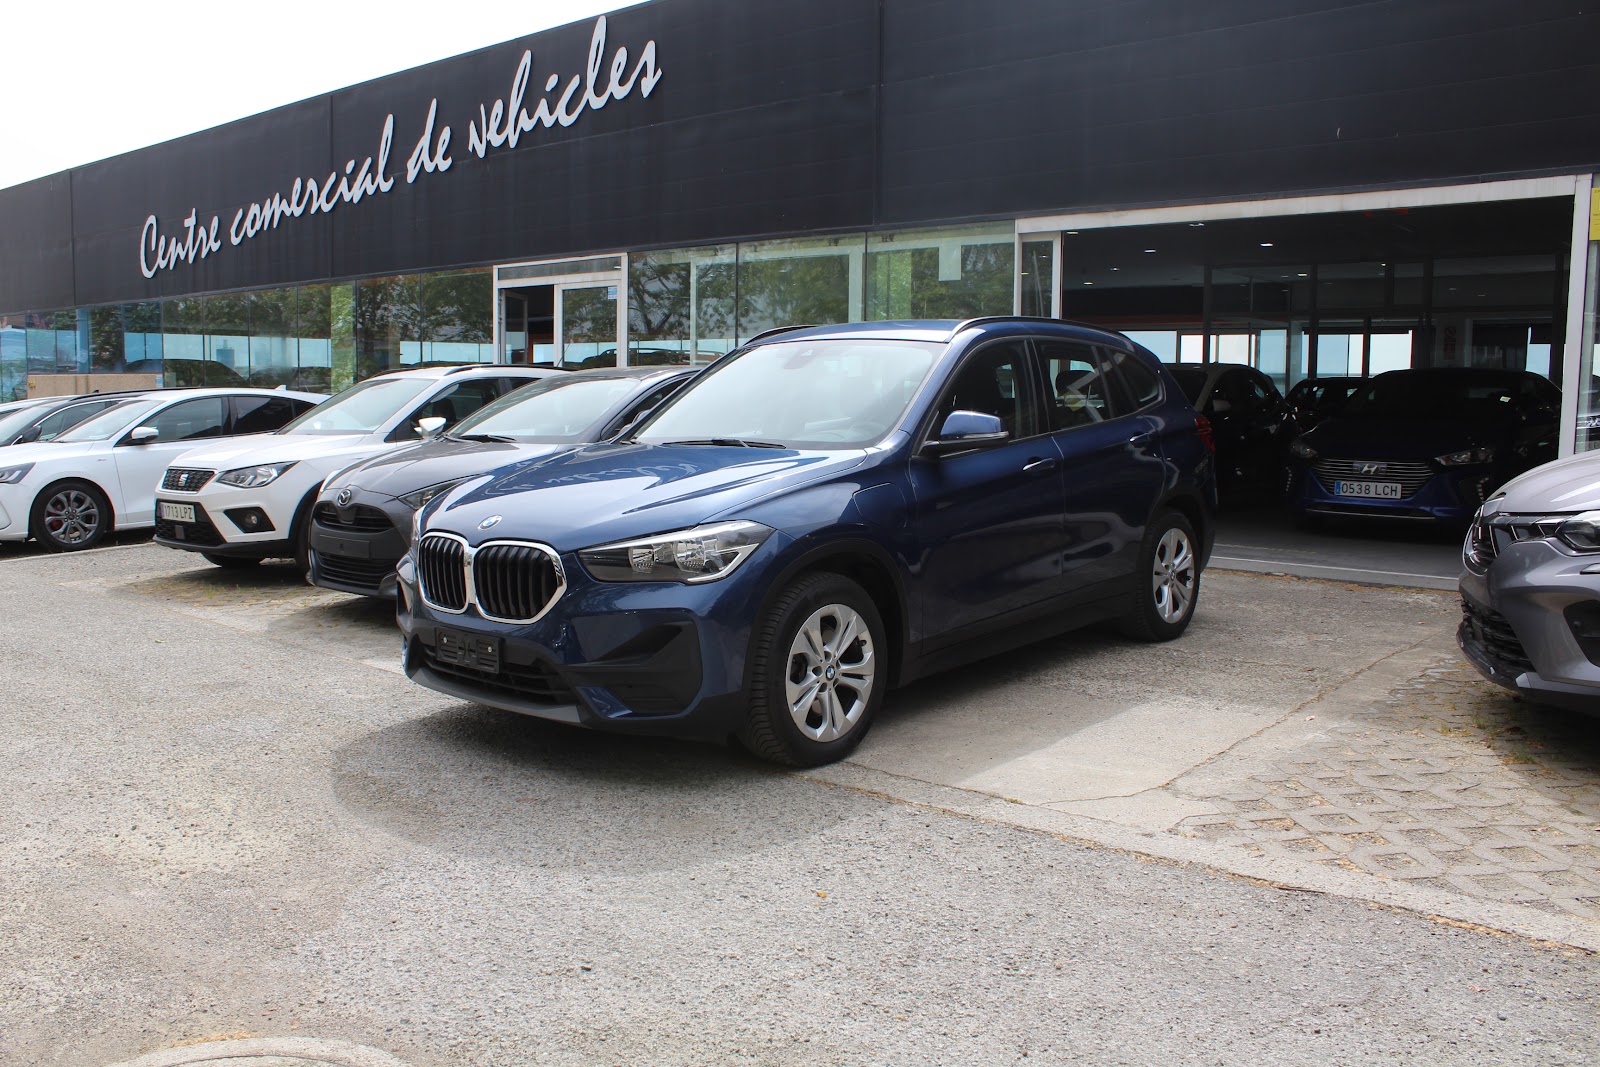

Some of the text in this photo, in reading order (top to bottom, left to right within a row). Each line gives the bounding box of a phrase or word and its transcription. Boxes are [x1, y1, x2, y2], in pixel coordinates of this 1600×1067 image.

[139, 15, 663, 279] Centre comercial de vehicles
[1341, 483, 1398, 496] 0538 LCH
[163, 504, 193, 520] 1713 LPZ
